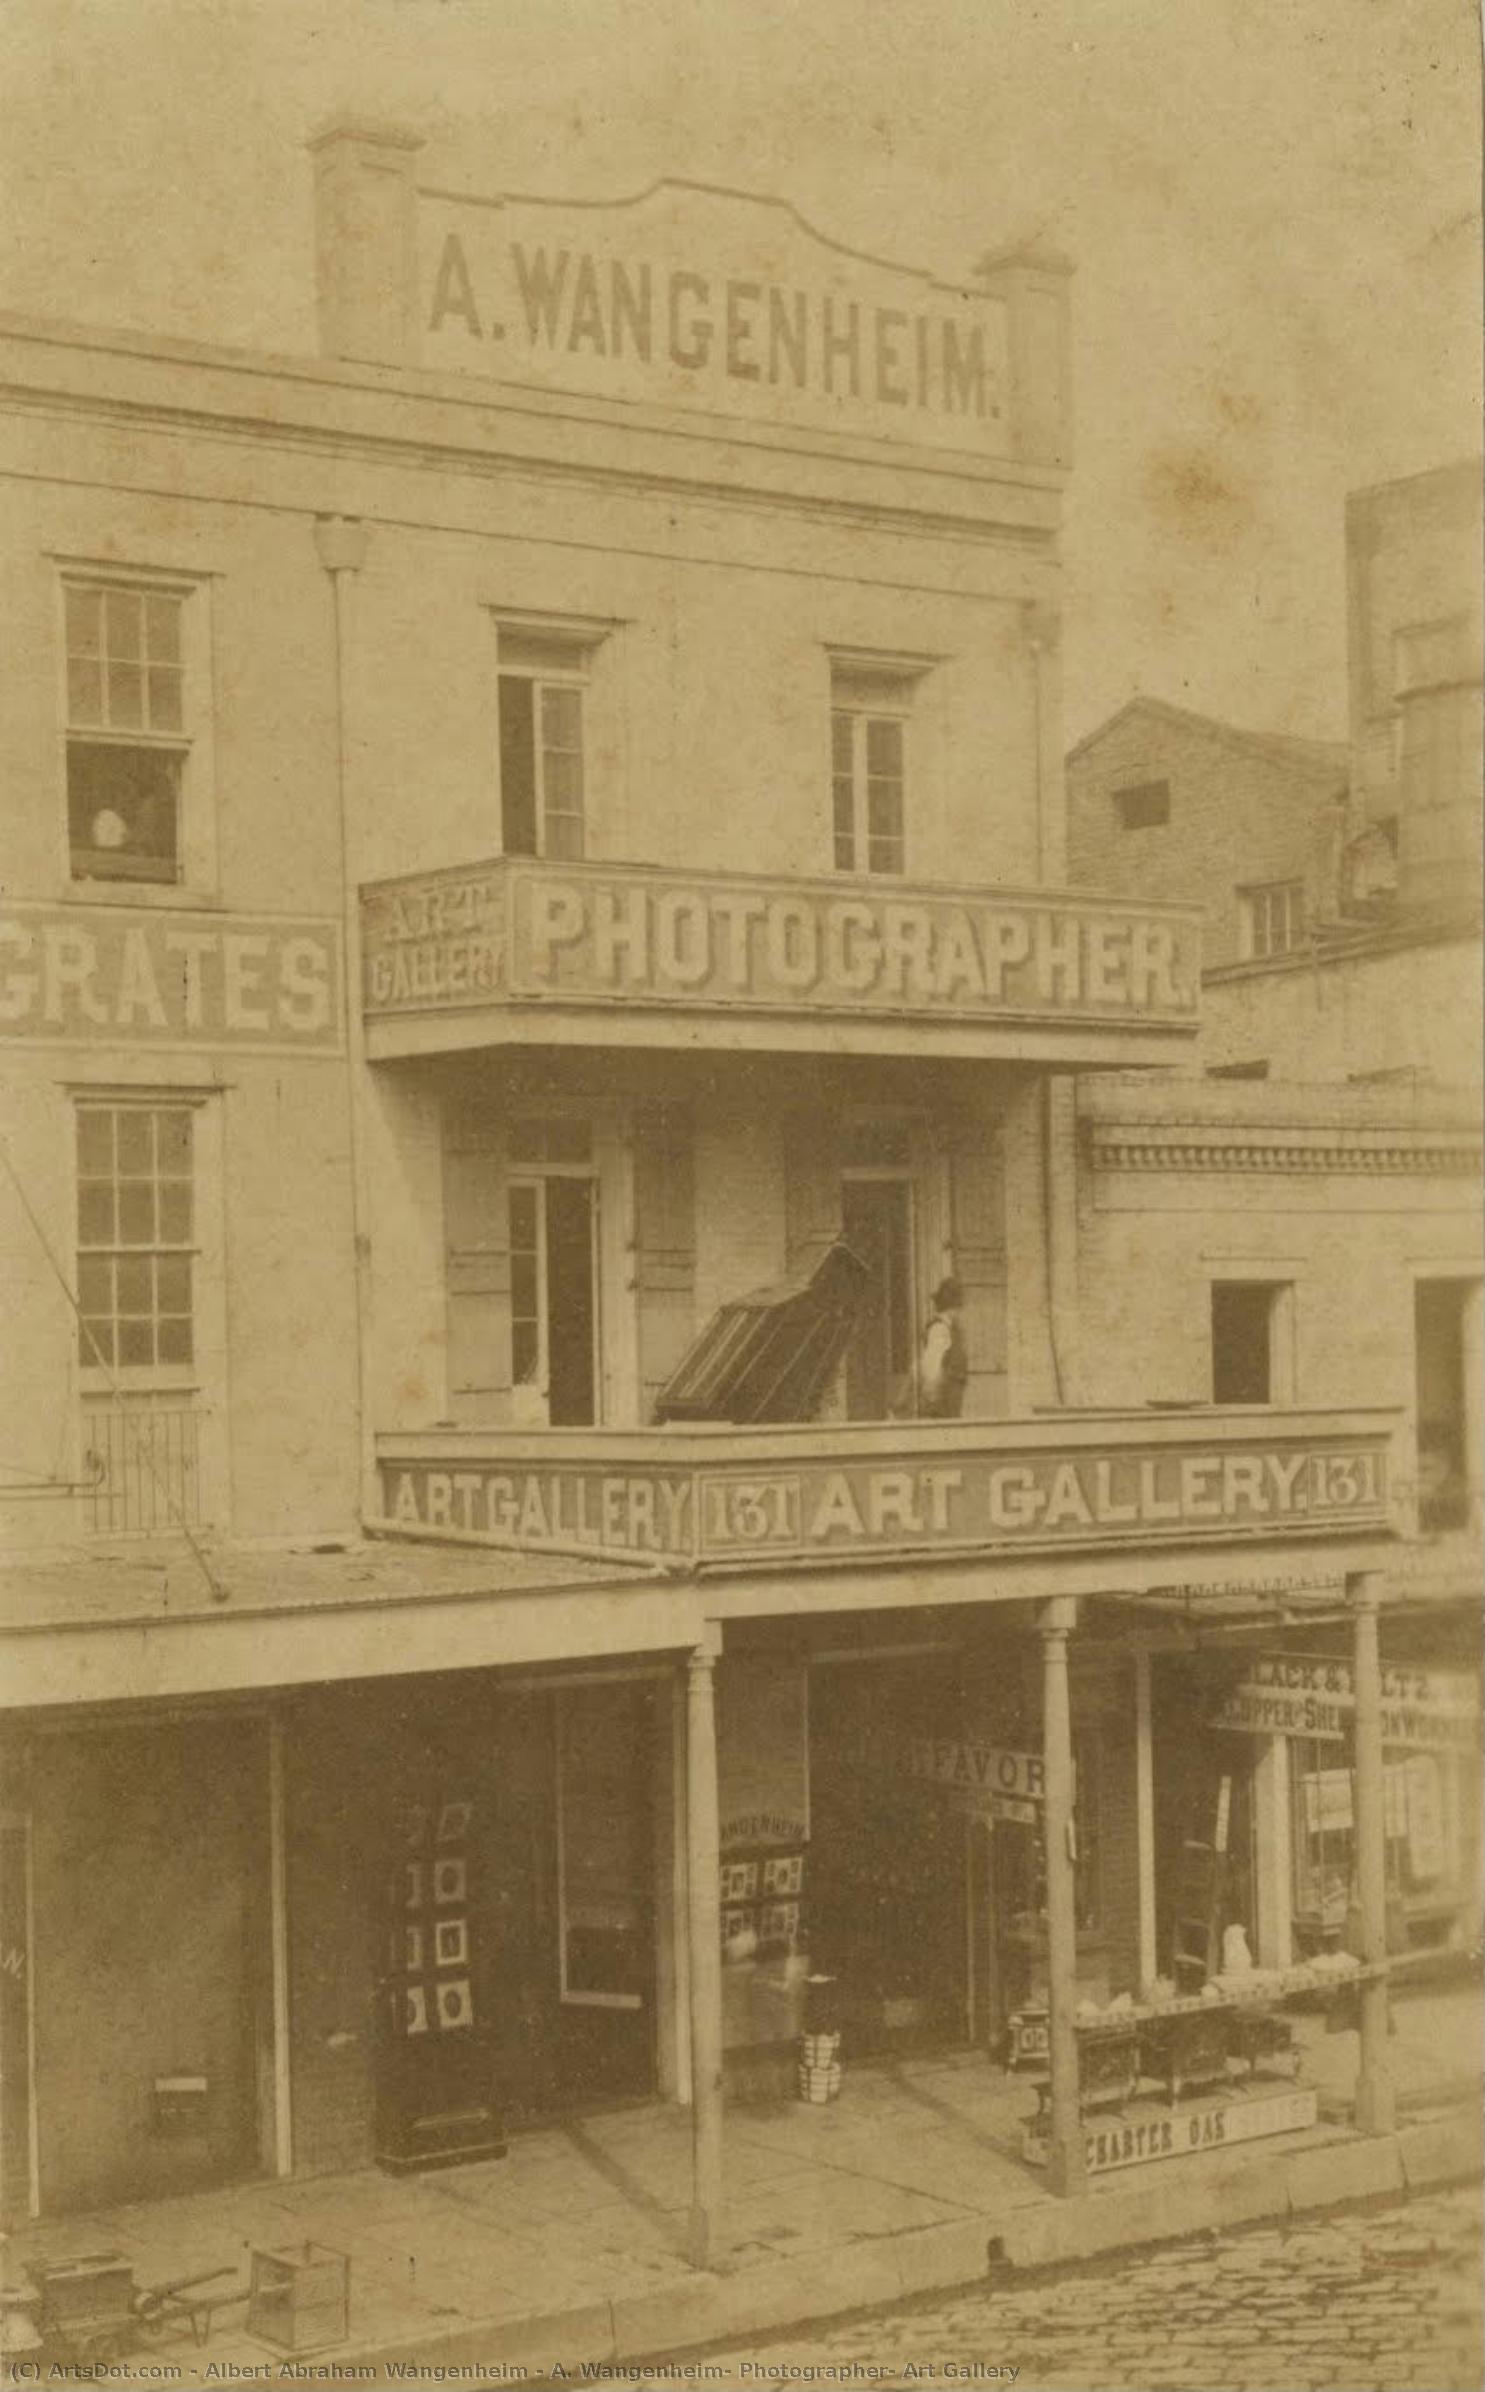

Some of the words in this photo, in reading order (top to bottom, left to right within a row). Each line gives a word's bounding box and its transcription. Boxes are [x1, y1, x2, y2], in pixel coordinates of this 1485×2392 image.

[428, 232, 507, 342] A.
[509, 241, 1000, 419] WANGENHEIM.
[383, 884, 490, 940] ART
[0, 919, 331, 1032] GRATES
[370, 936, 506, 1000] GALLERY
[398, 1472, 486, 1530] ART
[710, 1483, 798, 1543] 131
[809, 1467, 962, 1538] ART
[1315, 1456, 1379, 1508] 131
